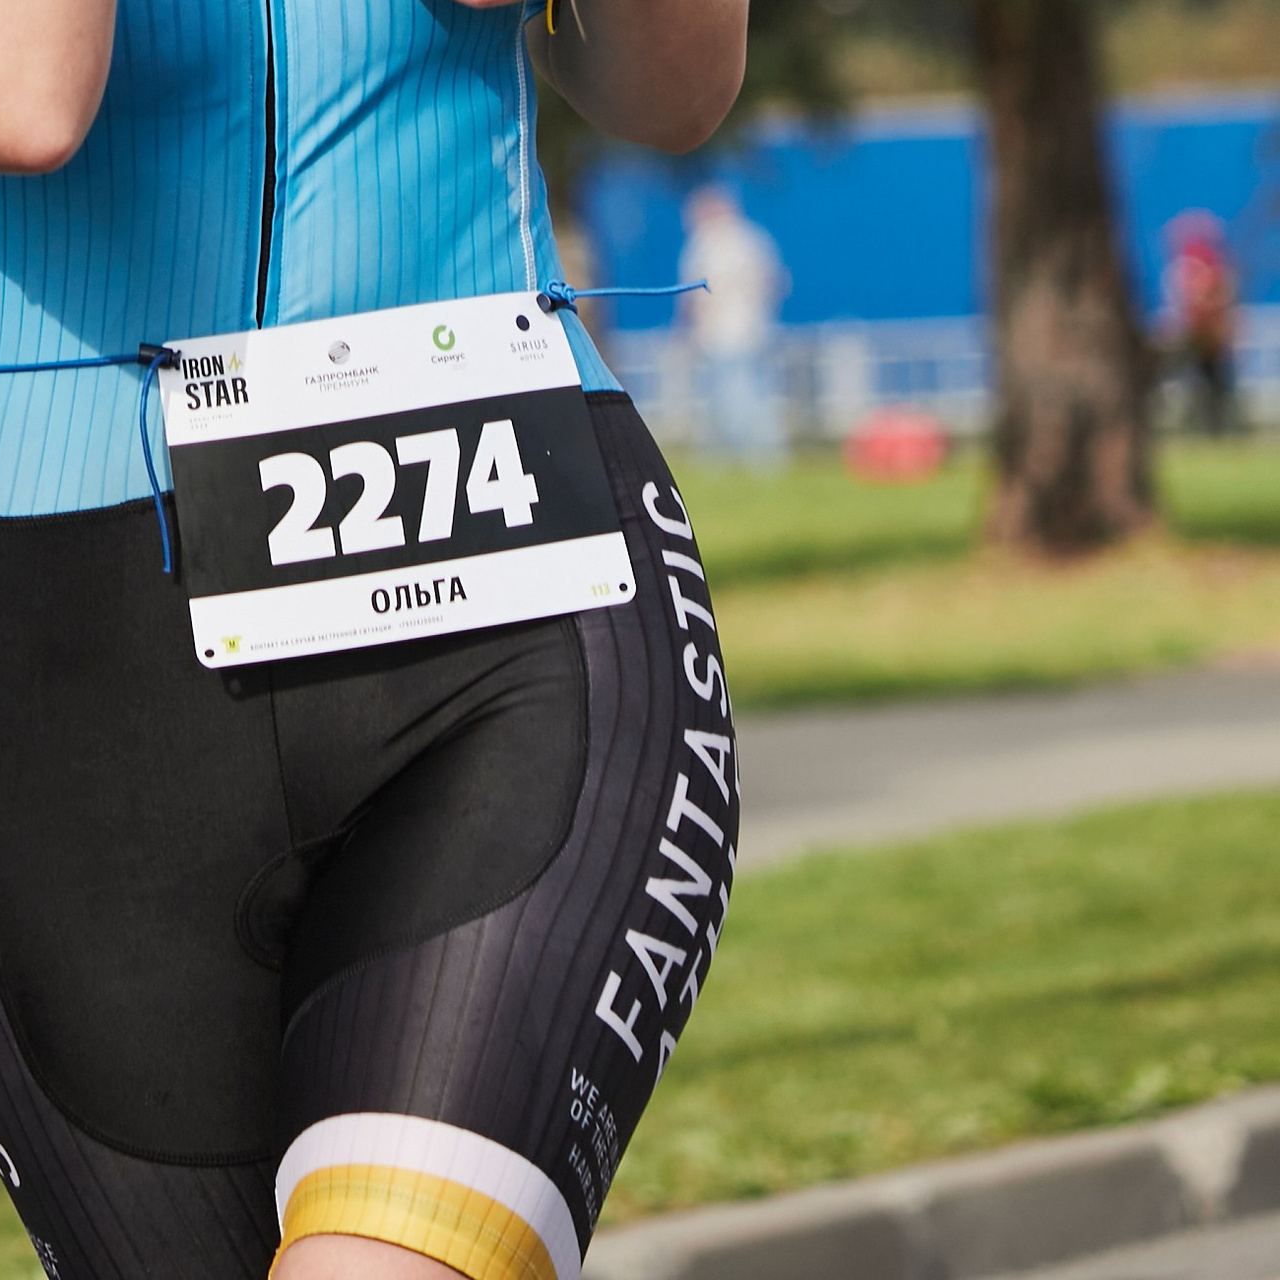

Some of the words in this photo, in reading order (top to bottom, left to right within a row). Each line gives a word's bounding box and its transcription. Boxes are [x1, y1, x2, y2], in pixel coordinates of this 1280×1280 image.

[431, 352, 466, 365] Сириус
[510, 339, 549, 354] SIRIUS
[182, 354, 225, 380] IRON
[305, 366, 379, 385] ГАЗПРОМБАНК
[185, 377, 249, 411] STAR
[319, 377, 370, 393] ПРЕМИУМ
[258, 419, 539, 566] 2274
[370, 576, 468, 615] ОЛЬГА
[595, 481, 732, 1064] FANTASTIC
[570, 1066, 600, 1111] WE
[598, 1102, 618, 1146] ARE
[570, 1098, 593, 1130] OF
